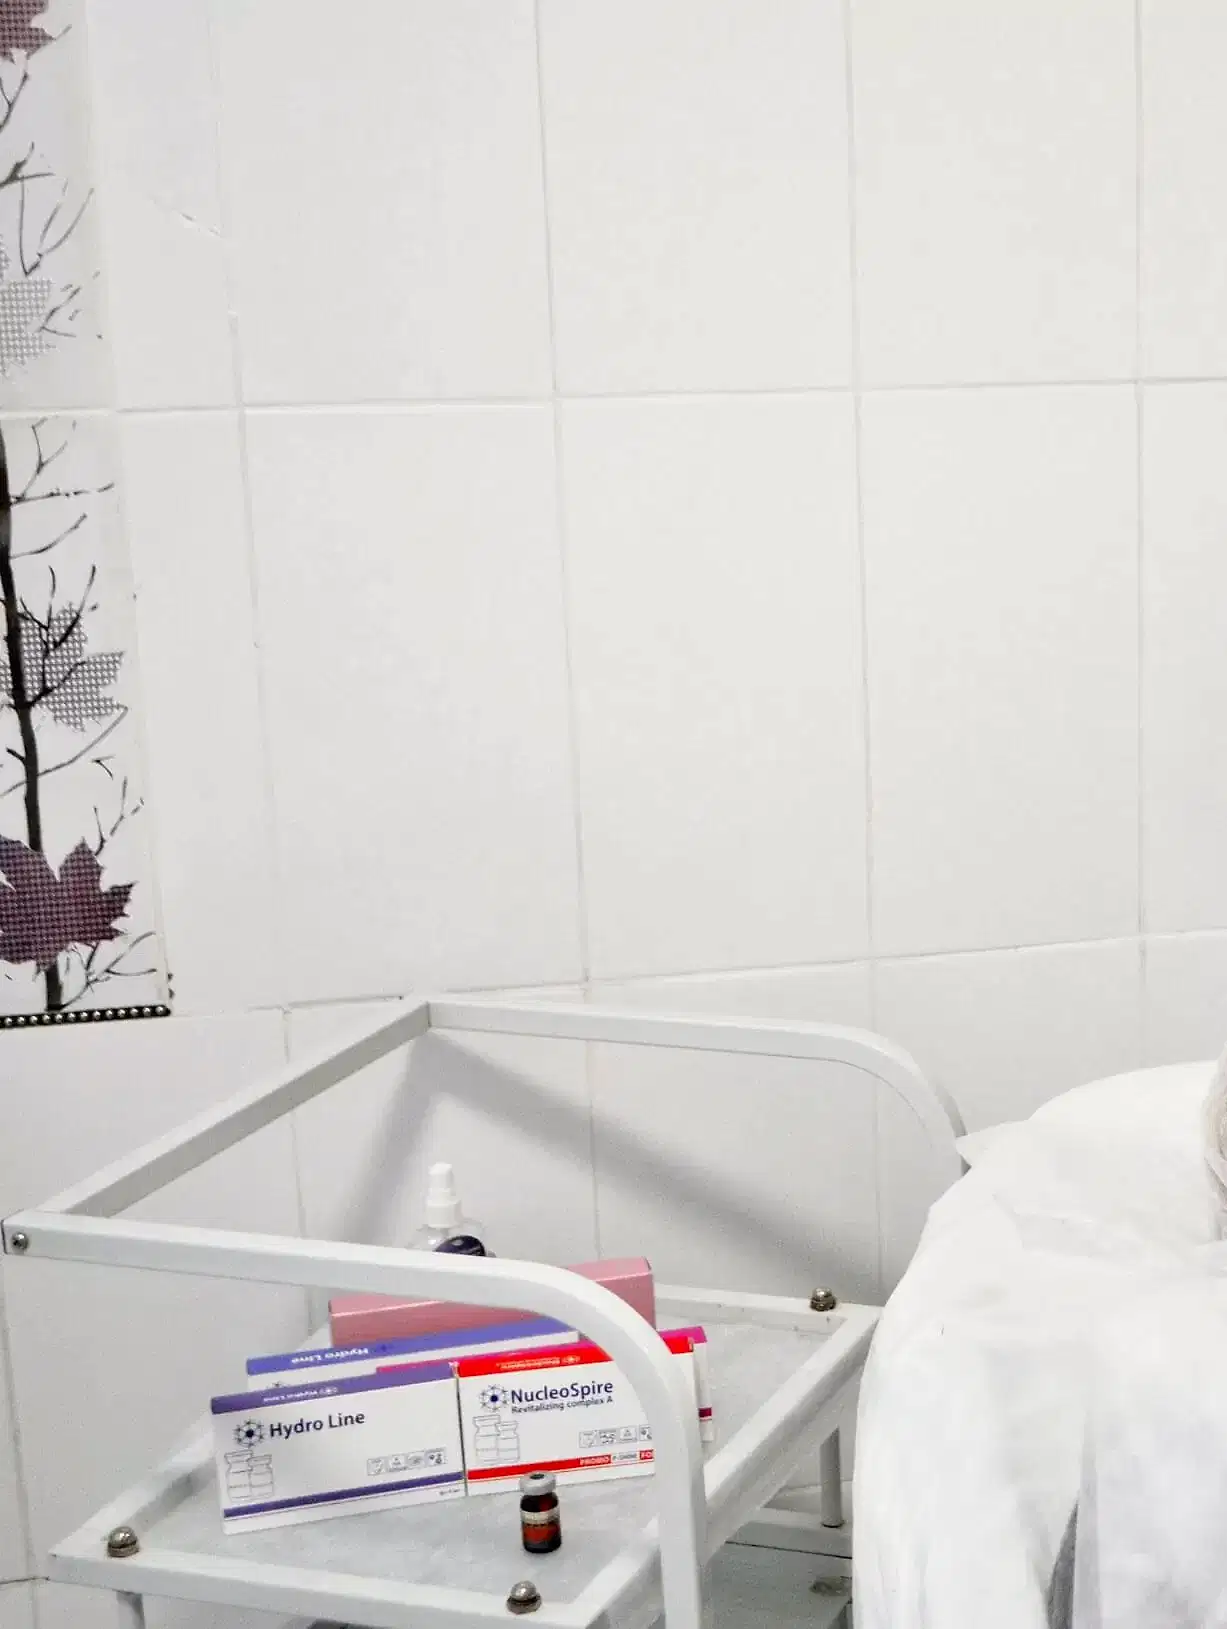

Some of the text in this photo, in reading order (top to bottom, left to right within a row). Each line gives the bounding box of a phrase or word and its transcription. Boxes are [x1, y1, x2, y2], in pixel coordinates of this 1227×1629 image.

[511, 1380, 614, 1404] NucleoSpire
[511, 1395, 614, 1415] Revitalizing complex A
[270, 1412, 366, 1440] Hydro Line
